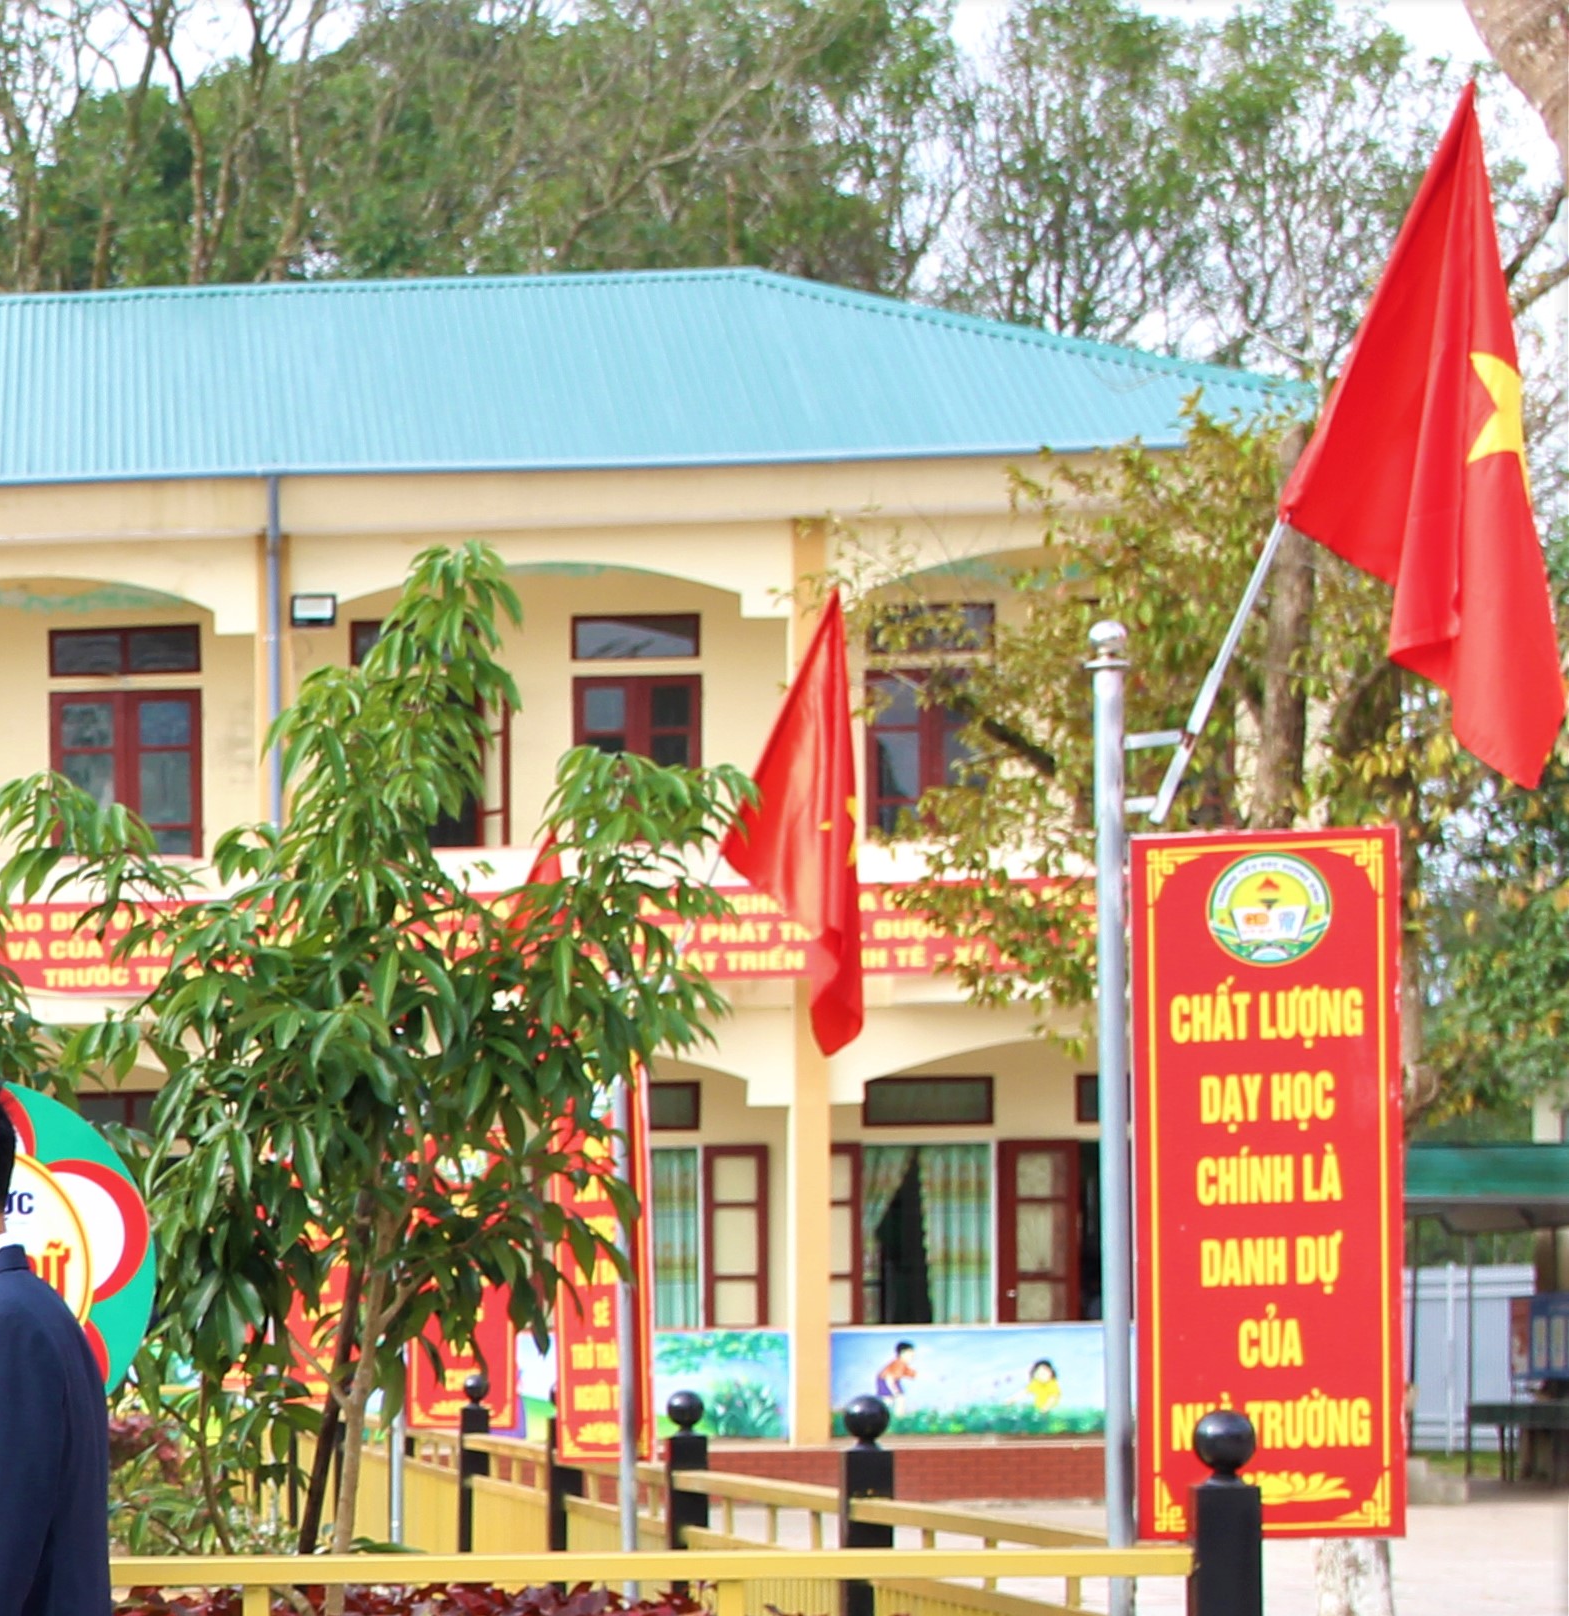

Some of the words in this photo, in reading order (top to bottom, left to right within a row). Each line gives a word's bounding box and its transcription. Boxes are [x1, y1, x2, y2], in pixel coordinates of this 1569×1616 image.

[1170, 975, 1251, 1044] CHẤT
[1259, 985, 1364, 1049] LƯỢNG
[1200, 1073, 1262, 1134] DẠY
[1270, 1071, 1335, 1131] HỌC
[1196, 1145, 1294, 1206] CHÍNH
[1303, 1142, 1343, 1202] LÀ
[1200, 1237, 1287, 1288] DANH
[1295, 1230, 1343, 1295] DỰ
[1238, 1303, 1304, 1368] CỦA
